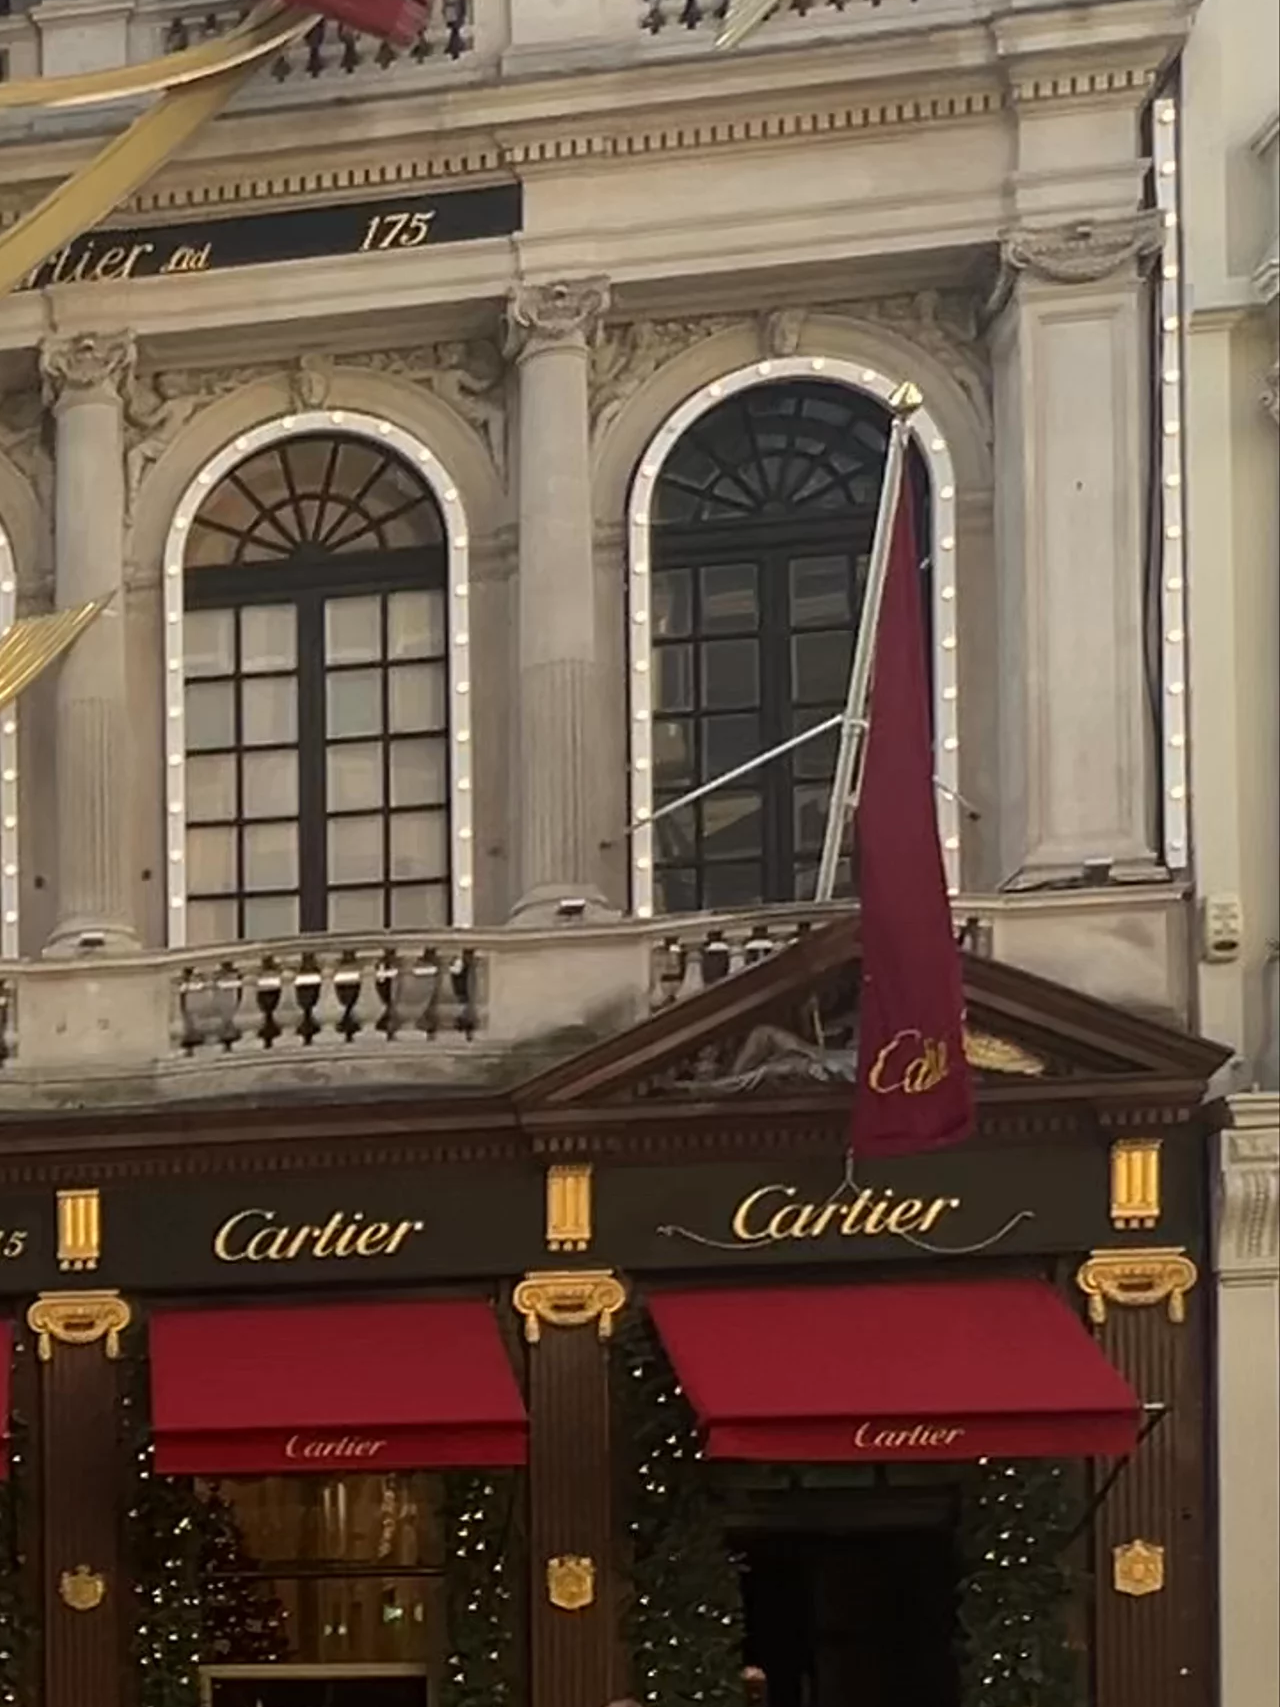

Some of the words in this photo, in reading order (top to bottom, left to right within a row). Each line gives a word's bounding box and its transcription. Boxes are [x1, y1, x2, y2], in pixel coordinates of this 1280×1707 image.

[16, 240, 155, 291] rtier
[360, 209, 437, 251] 175
[213, 1207, 425, 1263] Cartier
[732, 1184, 960, 1242] Cartier
[285, 1434, 388, 1458] Cartier
[854, 1421, 966, 1448] Cartier
